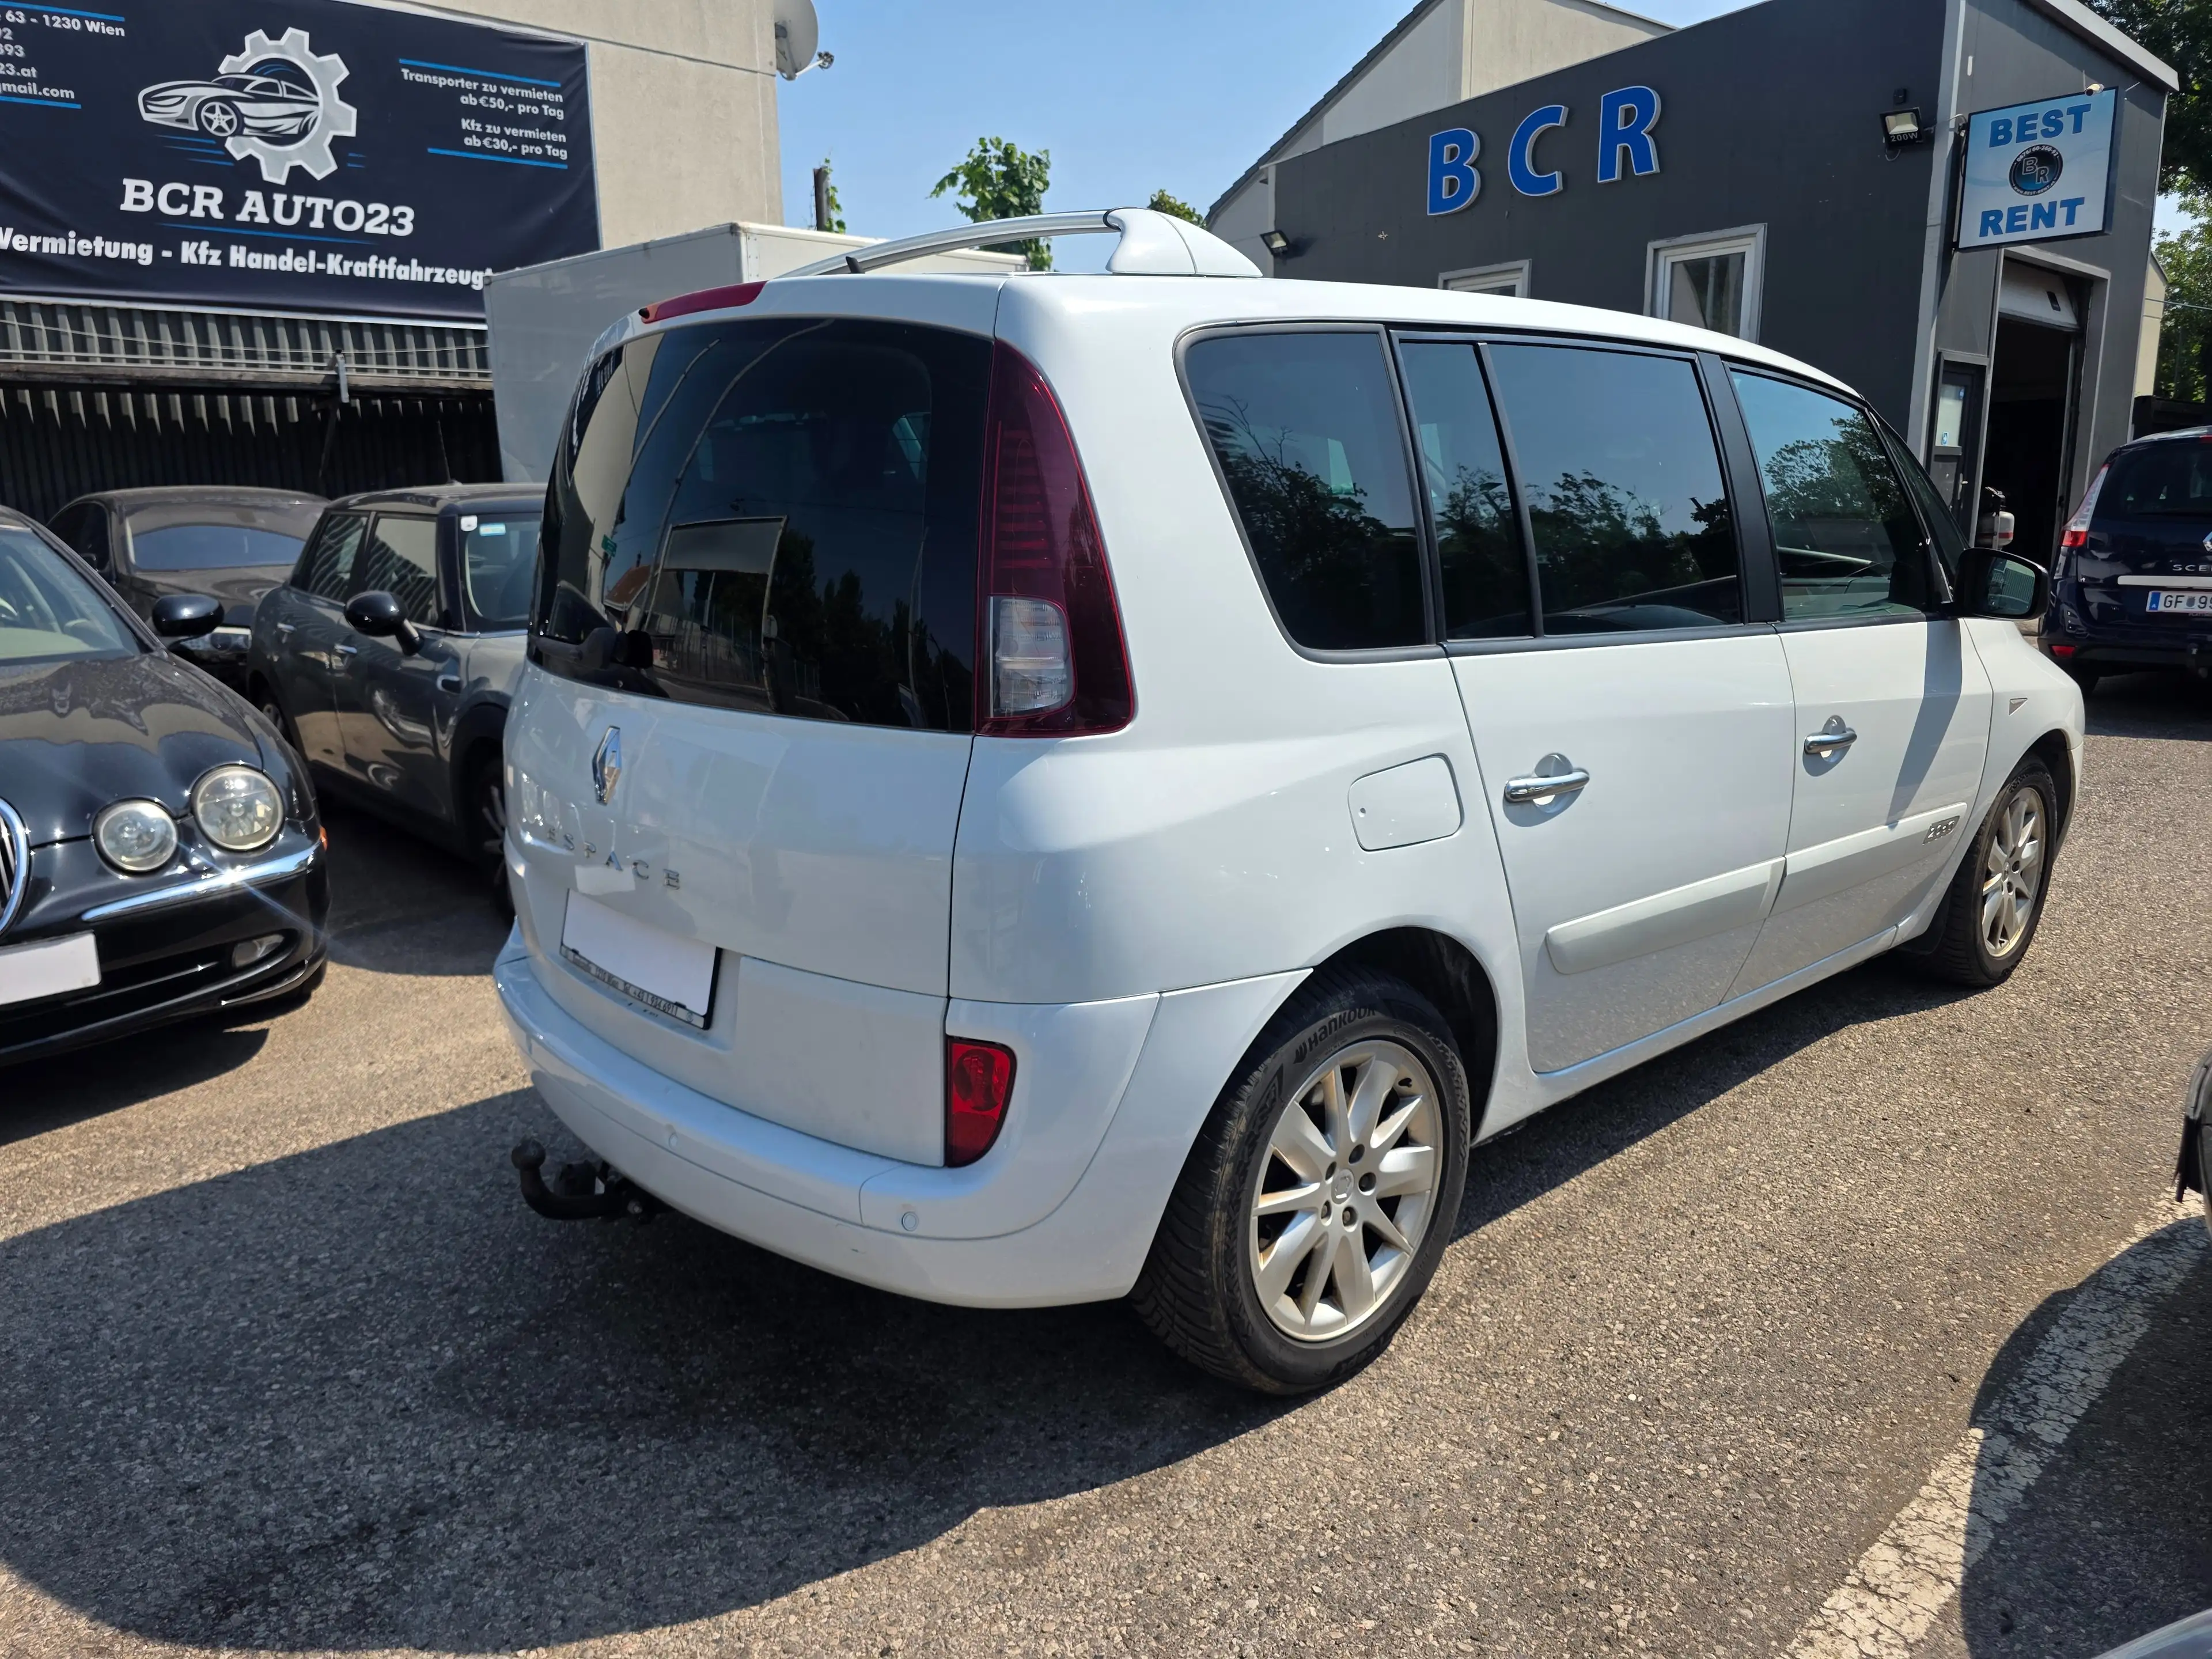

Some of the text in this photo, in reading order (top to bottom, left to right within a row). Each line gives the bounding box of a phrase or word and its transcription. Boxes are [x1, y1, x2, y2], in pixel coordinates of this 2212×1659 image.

[0, 27, 13, 40] 2
[5, 10, 26, 24] 63
[42, 14, 81, 31] 1230
[85, 20, 125, 36] Wien
[0, 82, 75, 99] mail.com
[401, 67, 563, 103] Transporter zu vermieten
[518, 103, 539, 115] pro
[541, 105, 564, 120] Tag
[461, 118, 566, 142] Kfz zu vermieten
[1891, 132, 1918, 142] 200W
[1988, 103, 2092, 148] BEST
[521, 143, 543, 156] pro
[545, 145, 567, 160] Tag
[1427, 85, 1661, 216] BCR
[120, 178, 415, 236] BCR AUTO23
[1979, 196, 2085, 237] RENT
[0, 227, 153, 266] Vermietung
[181, 241, 222, 266] Kfz
[2163, 594, 2212, 609] GF 9
[547, 828, 680, 890] ESPACE
